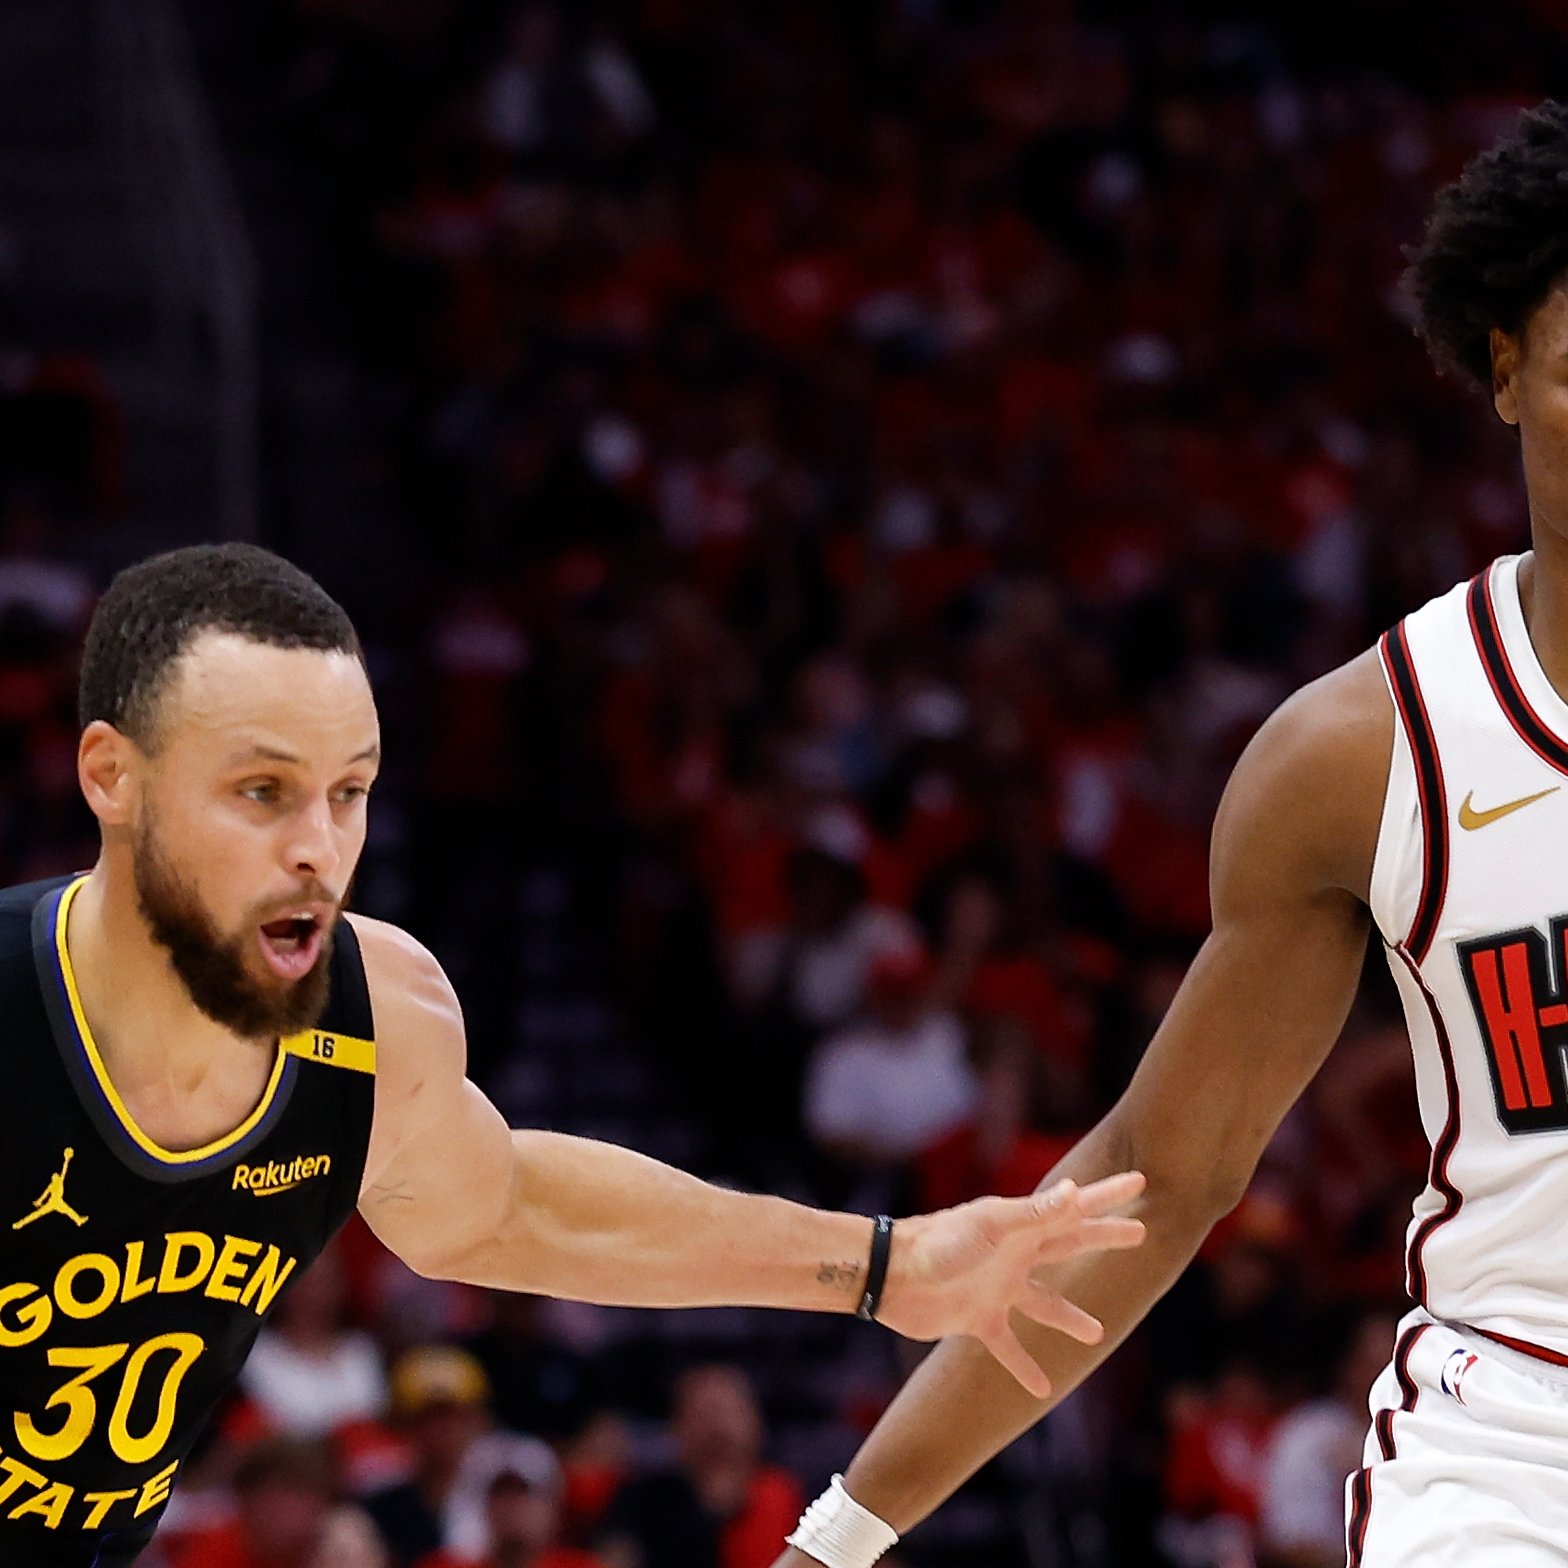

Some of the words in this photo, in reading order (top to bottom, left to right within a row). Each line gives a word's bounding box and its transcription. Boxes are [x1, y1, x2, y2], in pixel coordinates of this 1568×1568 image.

[313, 1034, 335, 1058] 16
[232, 1154, 331, 1197] Rakuten
[14, 1332, 207, 1464] 30
